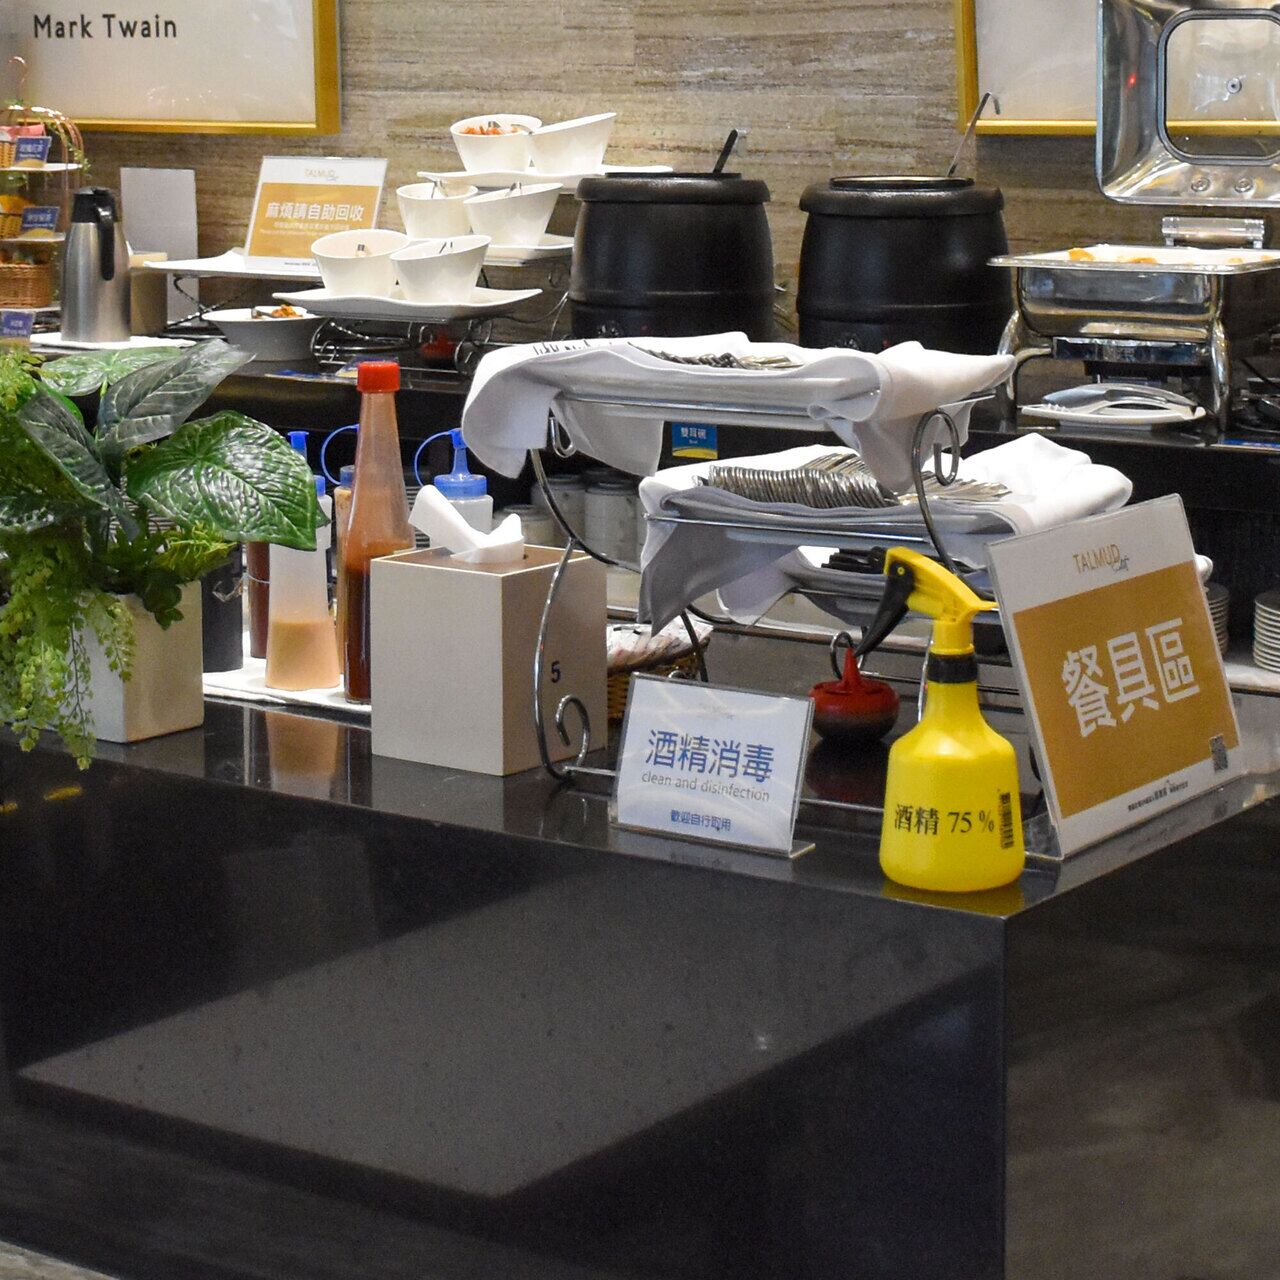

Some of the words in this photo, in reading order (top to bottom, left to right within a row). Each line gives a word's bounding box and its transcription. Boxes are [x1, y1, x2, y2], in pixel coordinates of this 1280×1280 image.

[33, 14, 93, 39] Mark
[103, 13, 177, 39] Twain
[1073, 544, 1120, 574] TALMUD
[551, 660, 561, 684] 5
[1061, 617, 1200, 738] 餐具區
[645, 729, 774, 783] 酒精消毒
[641, 771, 671, 787] clean
[675, 777, 697, 790] and
[700, 780, 770, 802] disinfection
[895, 804, 939, 835] 酒精
[947, 811, 973, 833] 75
[978, 810, 995, 833] %
